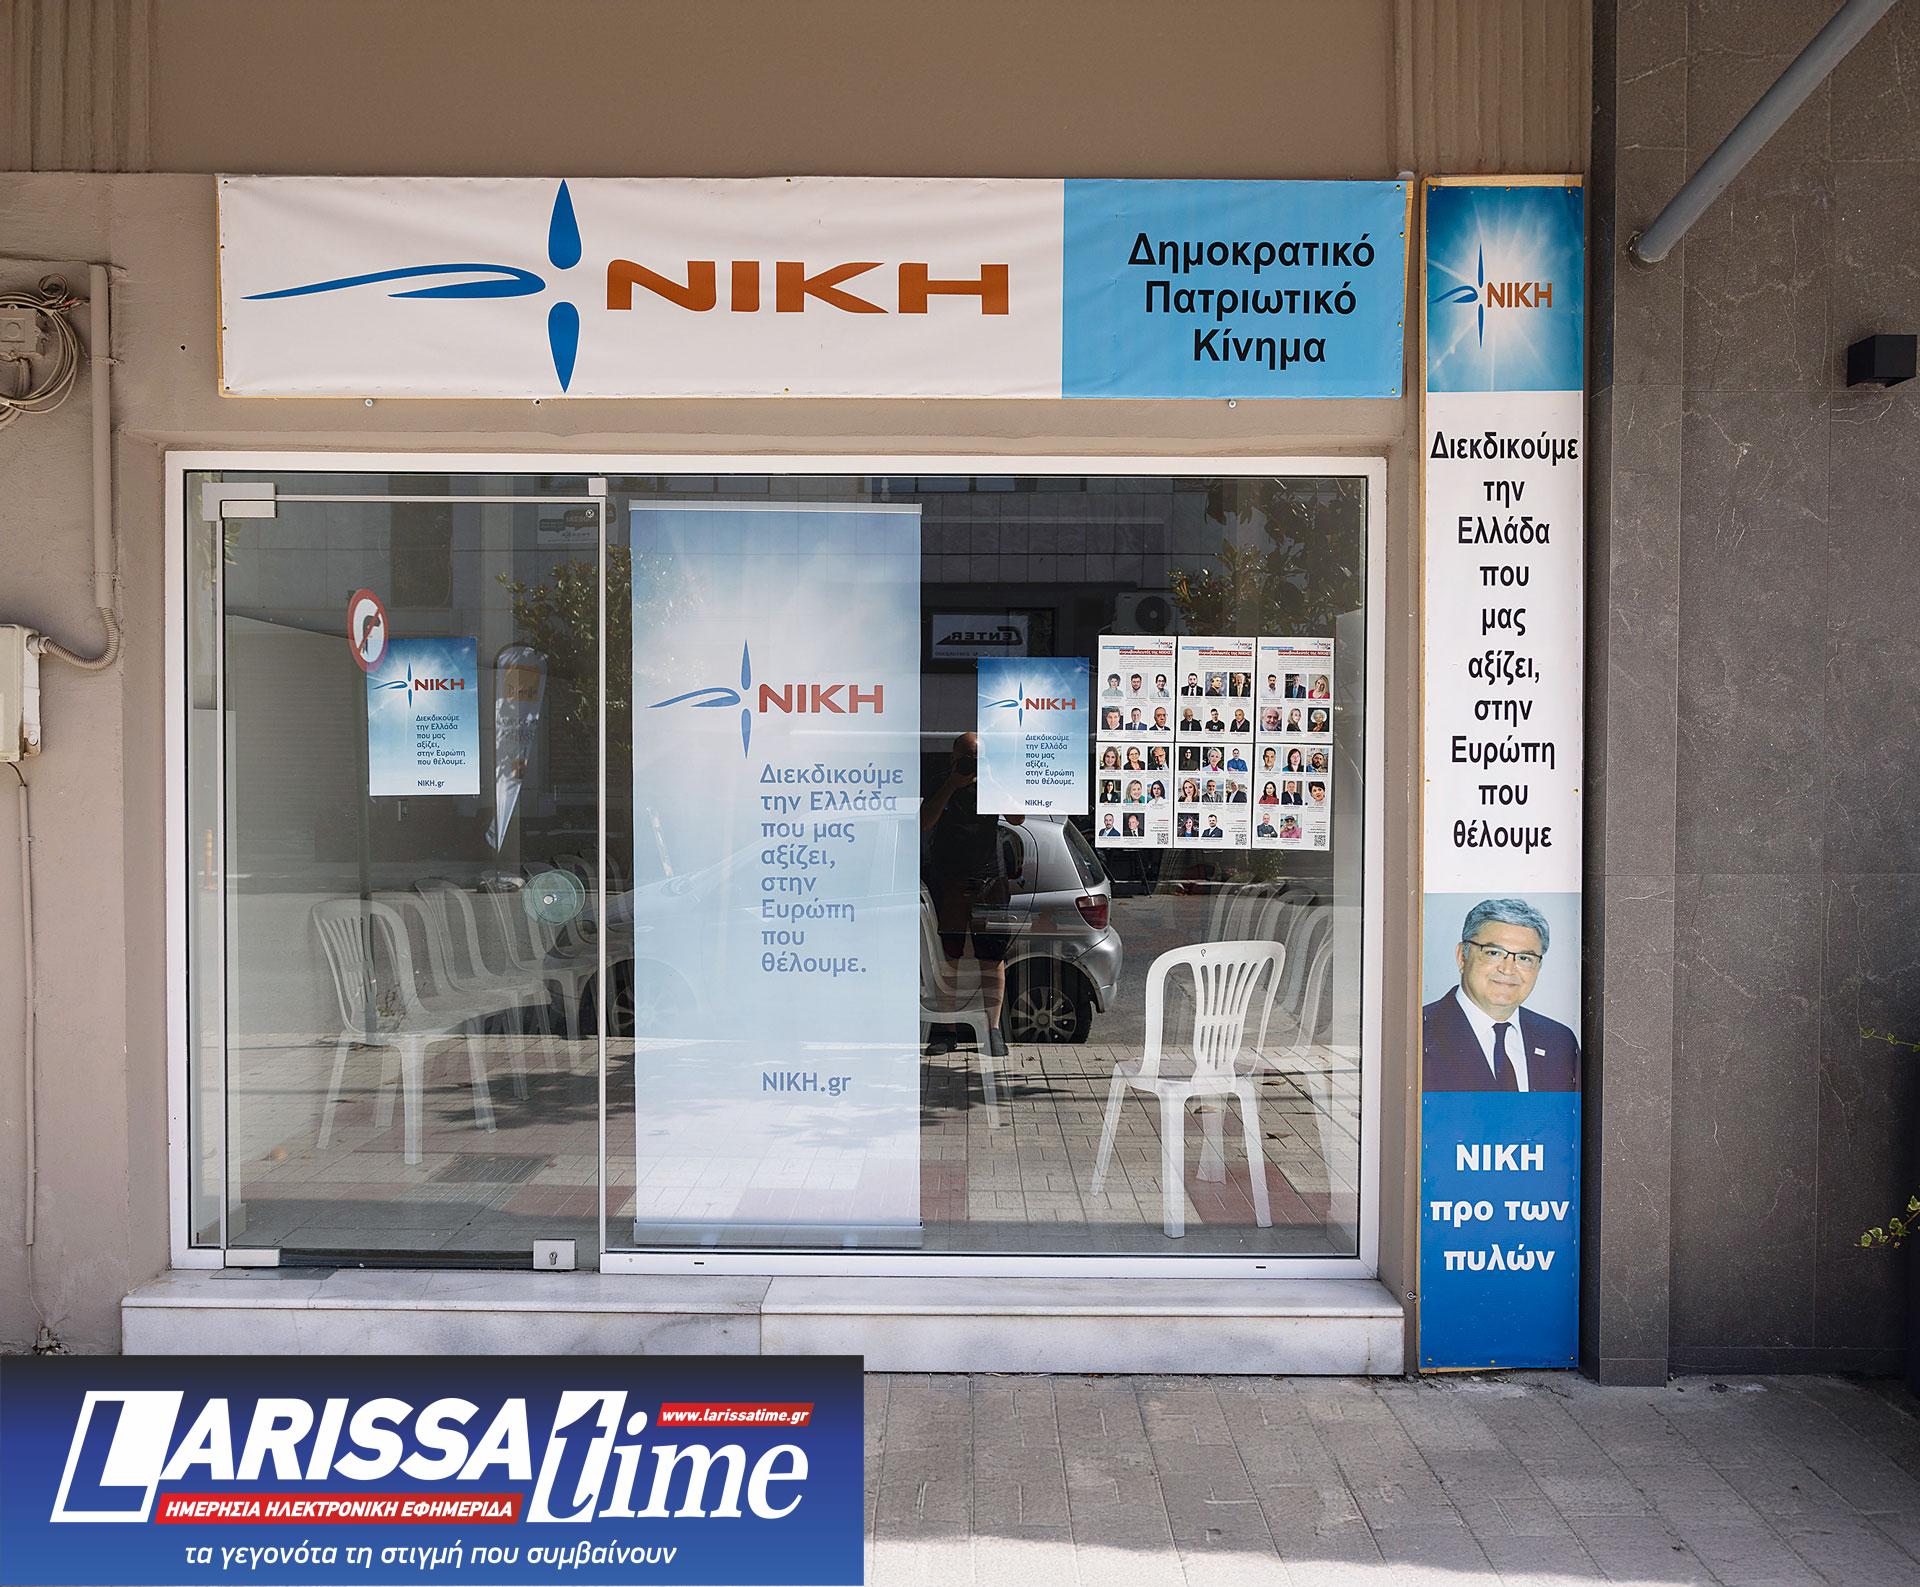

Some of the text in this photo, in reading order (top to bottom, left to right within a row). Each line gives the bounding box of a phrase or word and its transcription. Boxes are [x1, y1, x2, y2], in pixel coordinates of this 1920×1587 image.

[1128, 231, 1375, 270] Δημοκρατικό
[606, 259, 1009, 315] ΝΙΚΗ
[1145, 280, 1357, 317] Πατριωτικό
[1486, 281, 1552, 309] ΝΙΚΗ
[1193, 328, 1326, 370] Κίνημα
[1430, 431, 1579, 466] Διεκδικούμε
[1483, 480, 1525, 508] την
[1458, 516, 1550, 544] Ελλάδα
[1480, 565, 1529, 586] που
[1482, 608, 1526, 636] μας
[1468, 650, 1540, 685] αξίζει,
[415, 678, 465, 691] ΝΙΚΗ
[759, 683, 884, 714] ΝΙΚΗ
[1025, 698, 1076, 710] ΝΙΚΗ
[415, 714, 460, 722] Διεκδικούμε
[1474, 700, 1533, 727] στην
[416, 722, 458, 732] την Ελλάδα
[432, 732, 446, 740] μας
[1025, 734, 1069, 742] Διεκδικούμε
[417, 740, 440, 749] αξίζει,
[417, 749, 466, 758] στην Ευρώπη
[1026, 742, 1067, 751] την Ελλάδα
[1041, 752, 1055, 760] μας
[1451, 735, 1555, 770] Ευρώπη
[433, 758, 466, 766] θέλουμε.
[1025, 760, 1049, 769] αξίζει,
[1045, 769, 1075, 777] Ευρώπη
[417, 780, 444, 788] NIKH.gr
[760, 763, 904, 788] Διεκδικούμε
[1041, 777, 1075, 786] θέλουμε.
[761, 790, 897, 814] την Ελλάδα
[1024, 799, 1053, 807] NIKH.gr
[1478, 785, 1528, 805] που
[761, 821, 855, 843] που μας
[1453, 820, 1552, 854] θέλουμε
[761, 844, 836, 870] αξίζει,
[761, 875, 817, 896] στην
[762, 899, 855, 923] Ευρώπη
[762, 930, 805, 946] που
[761, 952, 867, 977] θέλουμε.
[762, 1072, 852, 1096] NIKH.gr
[1456, 1144, 1544, 1171] ΝΙΚΗ
[1430, 1200, 1570, 1228] προ των
[1443, 1244, 1555, 1271] πυλών
